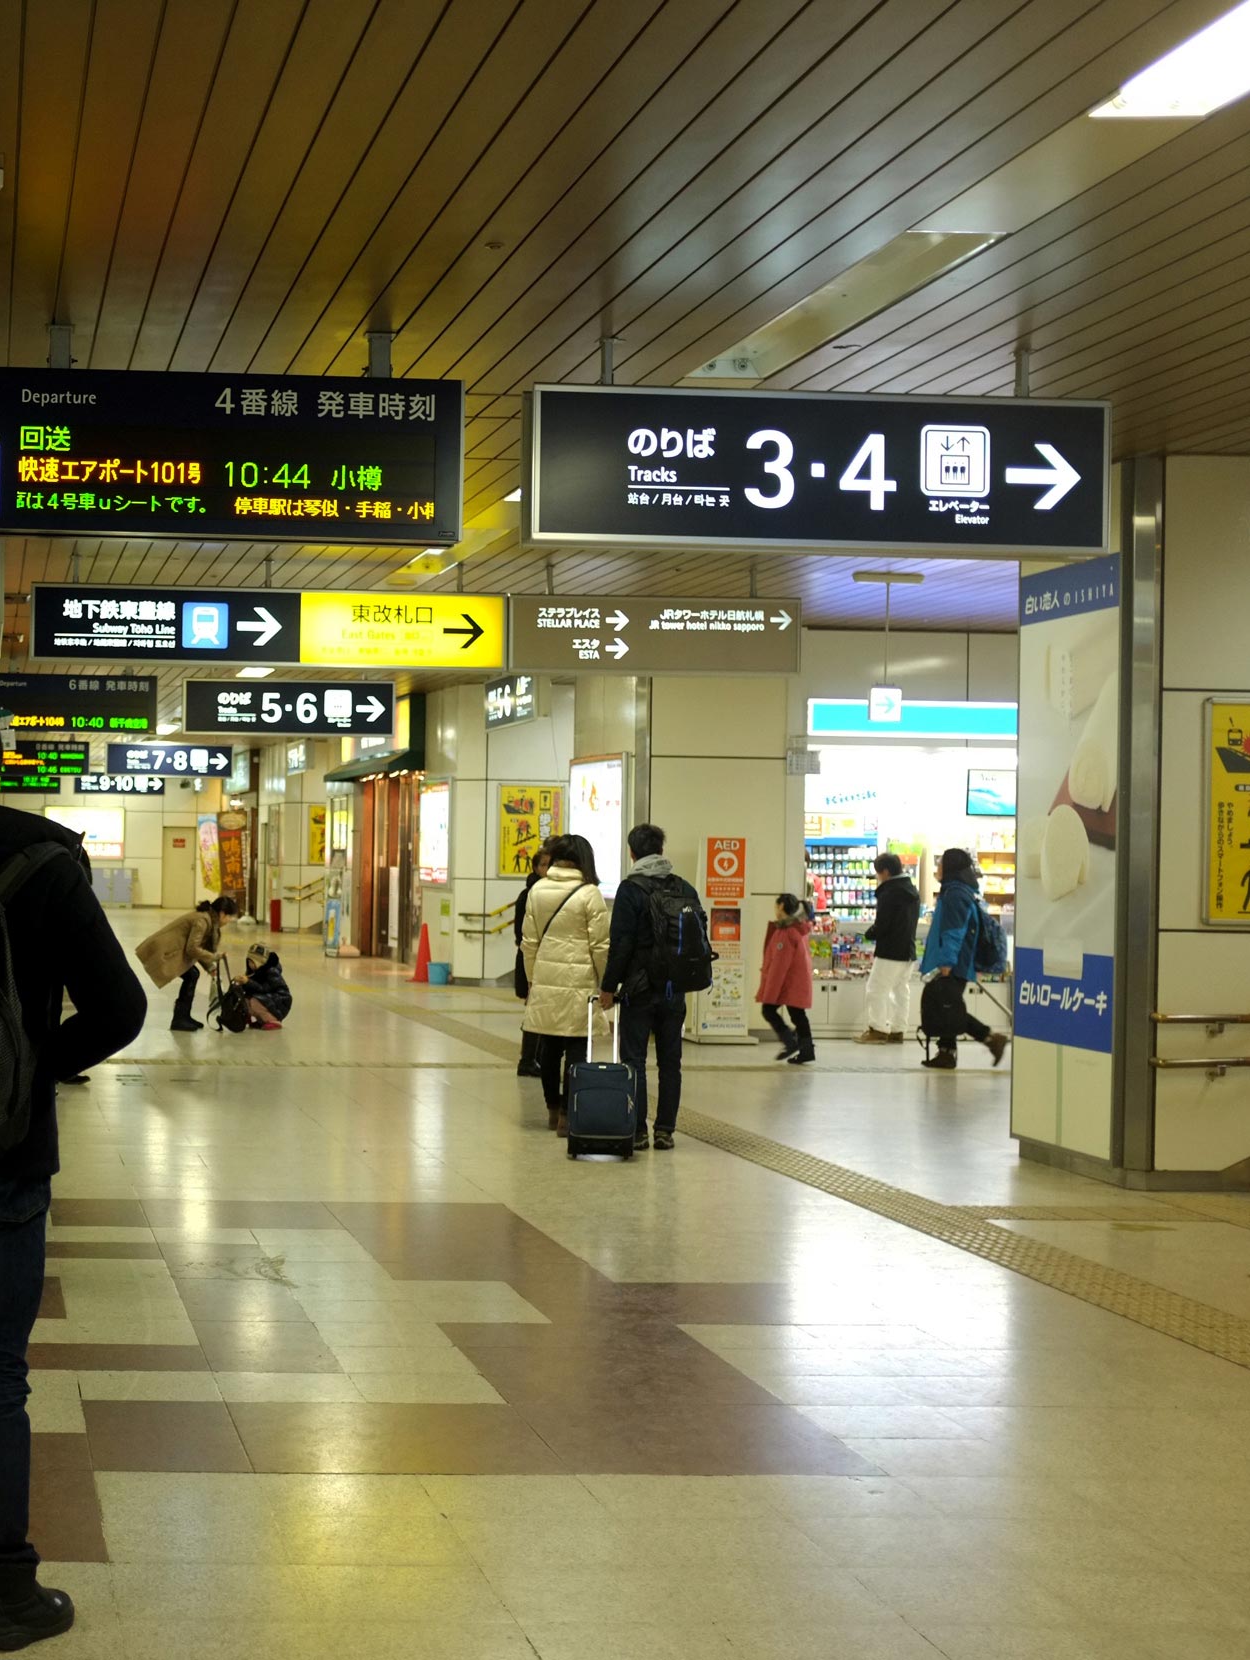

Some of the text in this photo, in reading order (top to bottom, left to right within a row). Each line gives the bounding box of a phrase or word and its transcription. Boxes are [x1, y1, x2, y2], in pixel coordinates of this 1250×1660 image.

[21, 389, 97, 407] Departure
[215, 388, 436, 422] 4番線 発車時刻
[19, 425, 71, 452] 回送
[627, 427, 717, 459] のりば
[18, 456, 382, 492] 快速エアポート101号 10:44 小樽
[628, 466, 678, 483] Tracks
[928, 500, 989, 513] エレベーター
[955, 513, 989, 525] Elevator
[63, 599, 175, 620] 地下鉄東豊線
[352, 604, 432, 624] 東改札口
[538, 607, 600, 618] ステラプレイス
[93, 622, 128, 635] Subway
[155, 624, 175, 634] Line
[537, 619, 765, 633] STELLAR PLACE JR tower hotel nikko sapporo
[572, 638, 600, 650] エスタ
[579, 650, 600, 660] ESTA
[69, 680, 149, 692] 6番線 発車時刻
[71, 717, 104, 728] 10:40
[714, 840, 740, 850] AED
[1019, 980, 1108, 1016] 白いロールケーキ
